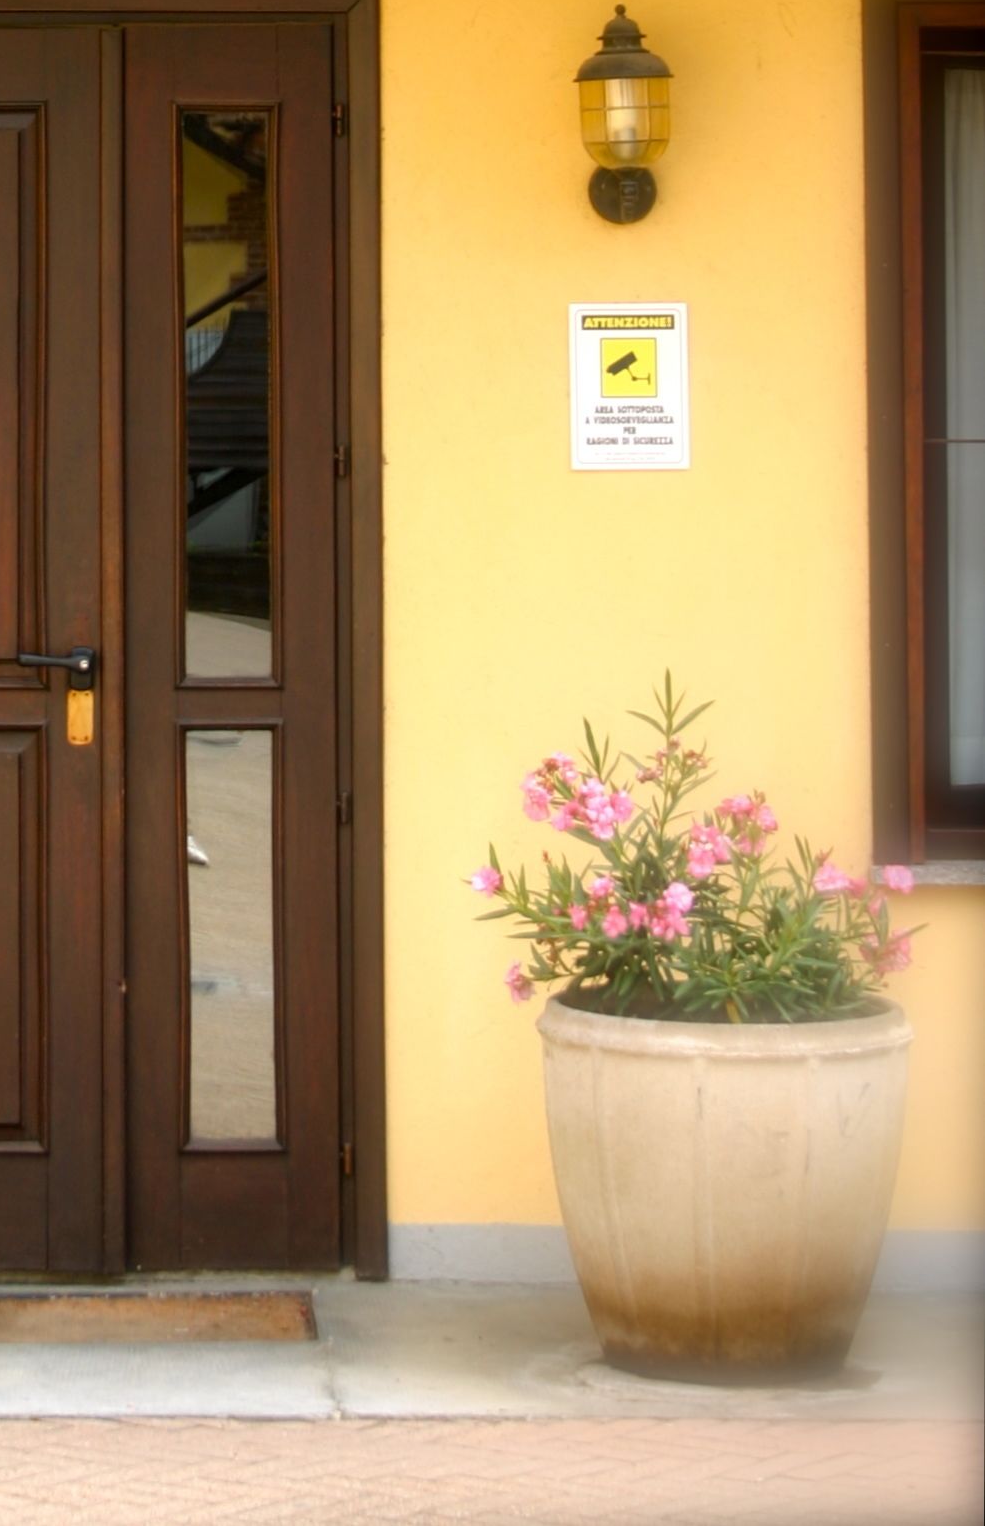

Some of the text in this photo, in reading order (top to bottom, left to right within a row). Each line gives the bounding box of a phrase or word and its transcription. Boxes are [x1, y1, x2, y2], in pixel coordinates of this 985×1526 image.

[583, 317, 672, 328] ATTENZIONE!
[594, 406, 614, 414] AREA
[586, 437, 673, 445] RAGIONI DI SICUREZZA
